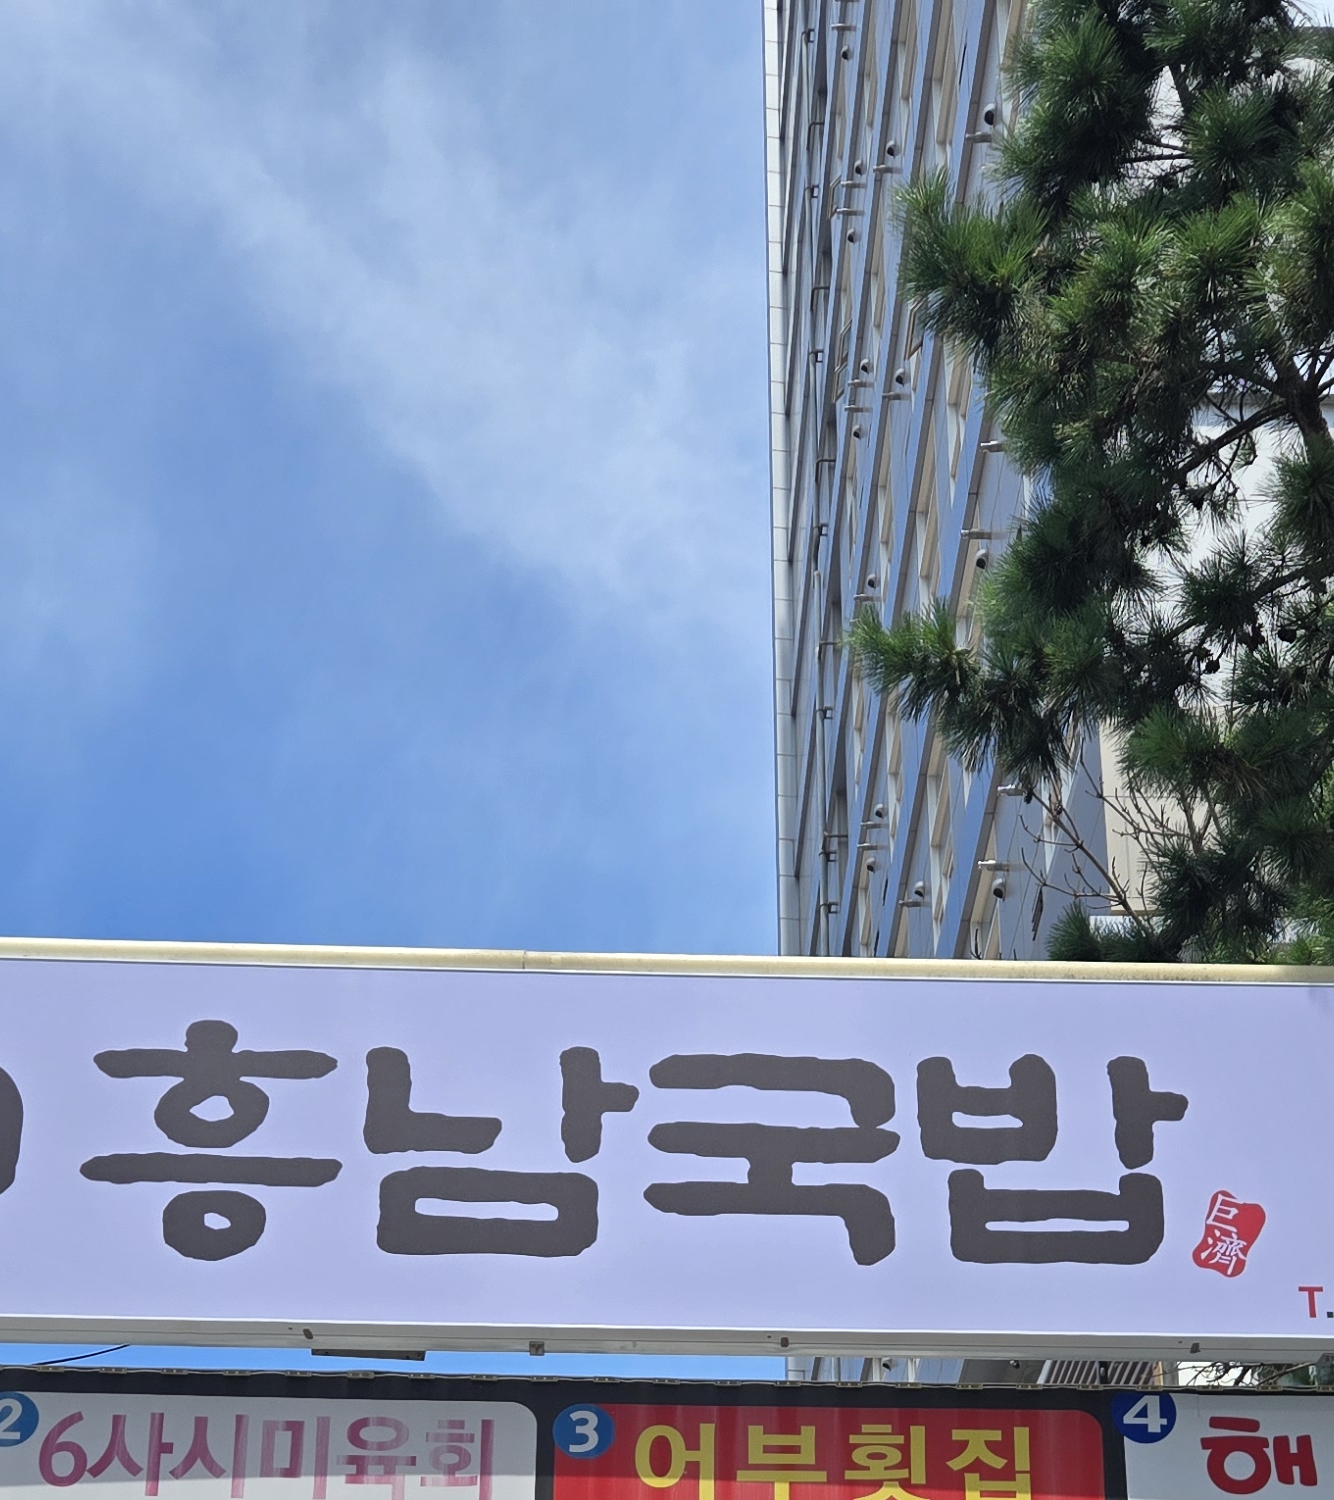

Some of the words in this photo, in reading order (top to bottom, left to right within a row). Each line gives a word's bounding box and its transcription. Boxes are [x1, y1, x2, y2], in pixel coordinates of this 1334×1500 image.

[80, 1019, 1189, 1267] 흥남국밥
[568, 1410, 599, 1453] 3
[1123, 1395, 1168, 1433] 4
